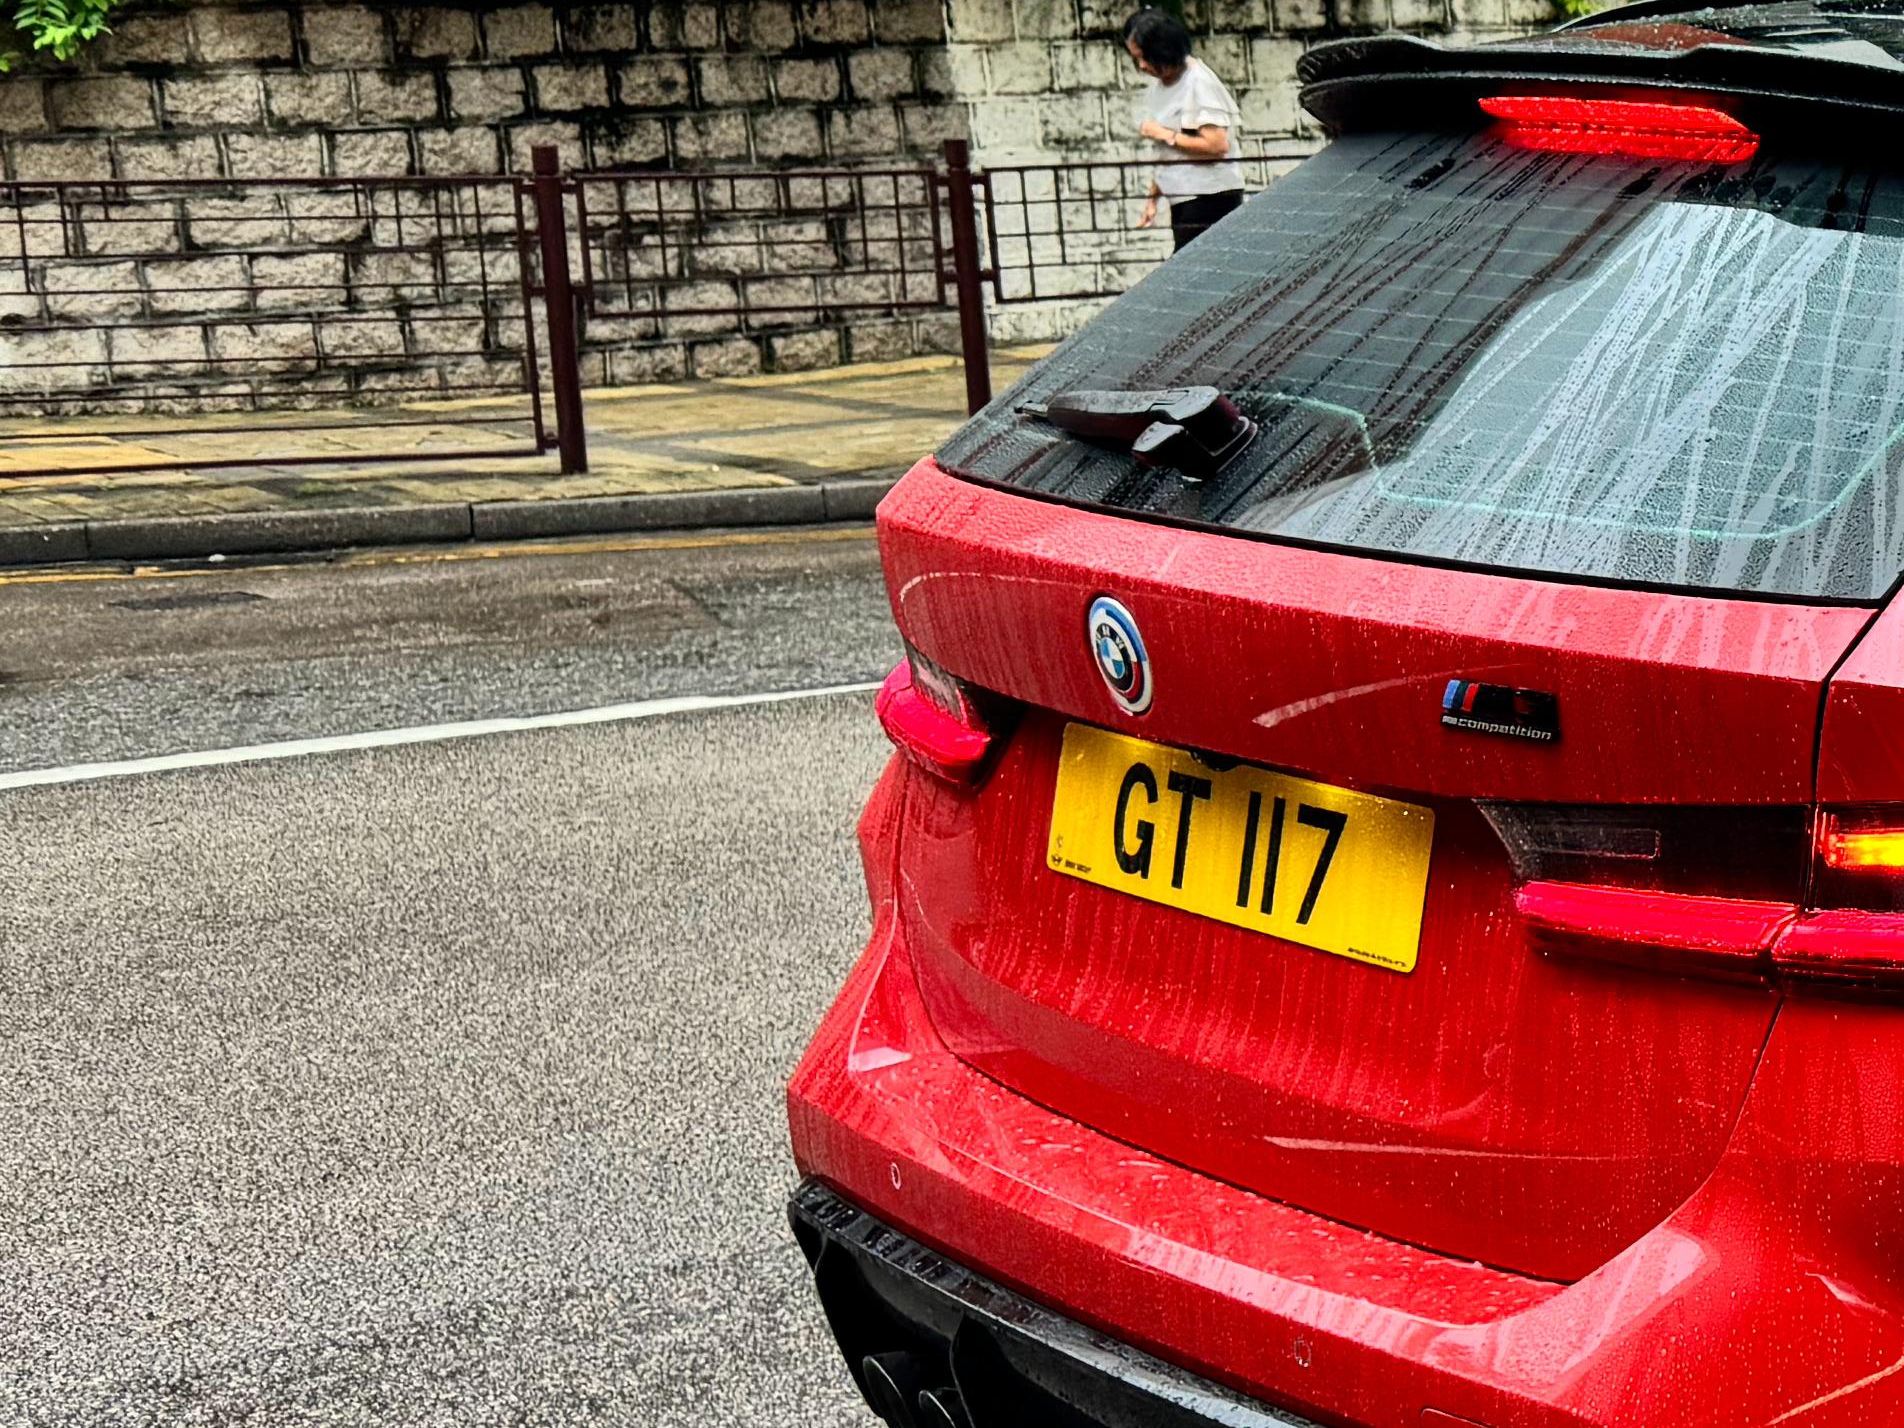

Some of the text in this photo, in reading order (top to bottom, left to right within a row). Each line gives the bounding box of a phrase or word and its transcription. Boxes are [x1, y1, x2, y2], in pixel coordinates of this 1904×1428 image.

[1457, 718, 1551, 740] competition
[1114, 762, 1348, 925] GT 117
